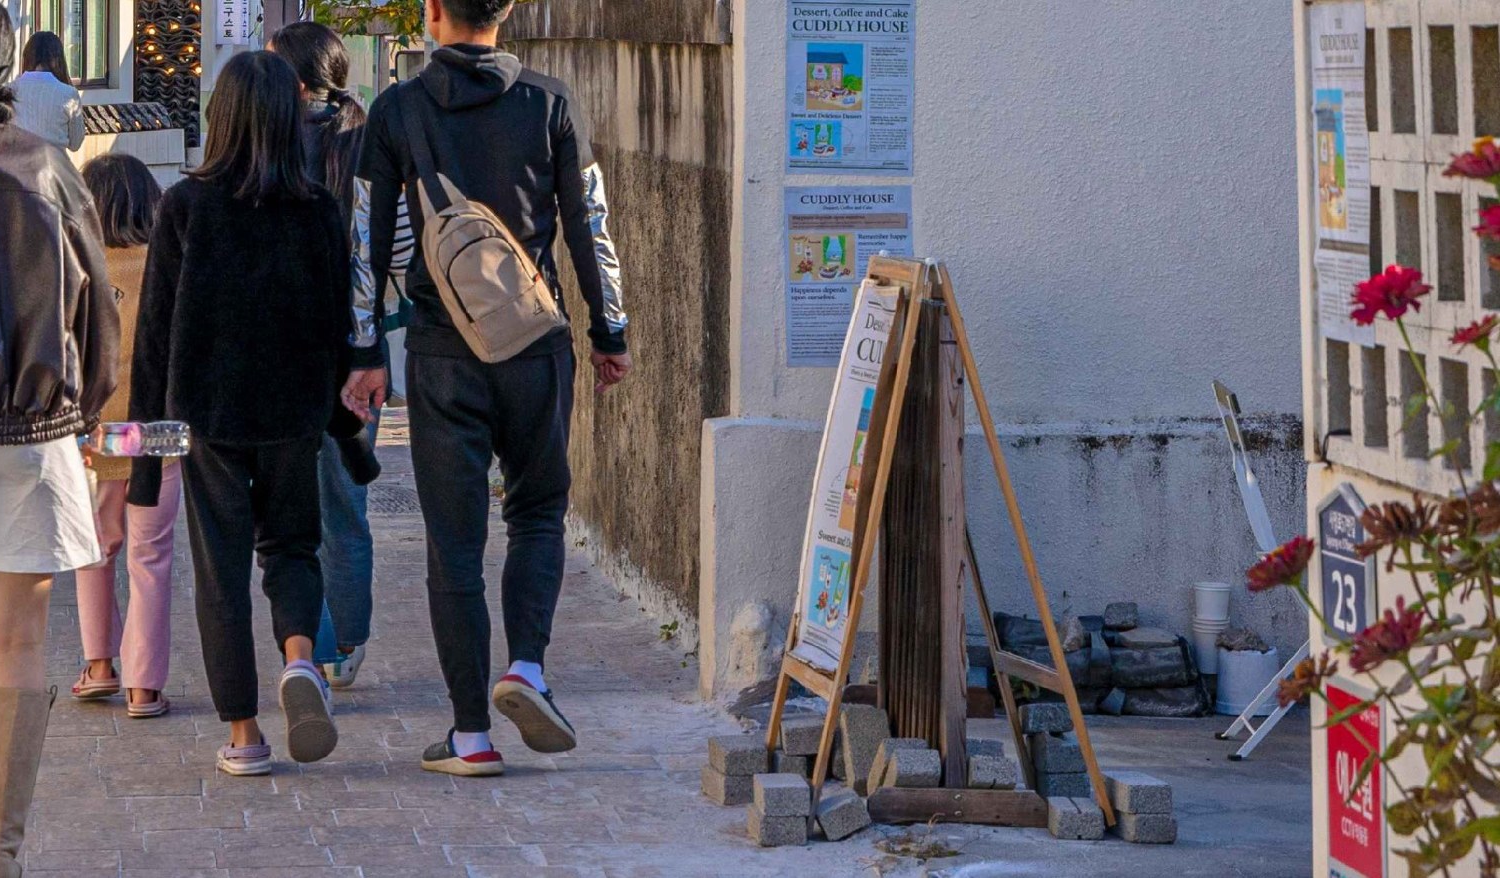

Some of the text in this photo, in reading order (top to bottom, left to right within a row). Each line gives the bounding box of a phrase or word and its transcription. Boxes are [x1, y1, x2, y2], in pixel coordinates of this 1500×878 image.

[793, 7, 909, 18] Dessert, Coffee and Cake
[792, 19, 909, 33] CUDDLY HOUSE
[800, 193, 895, 205] CUDDLY HOUSE
[823, 286, 847, 294] depends
[1332, 570, 1357, 633] 23
